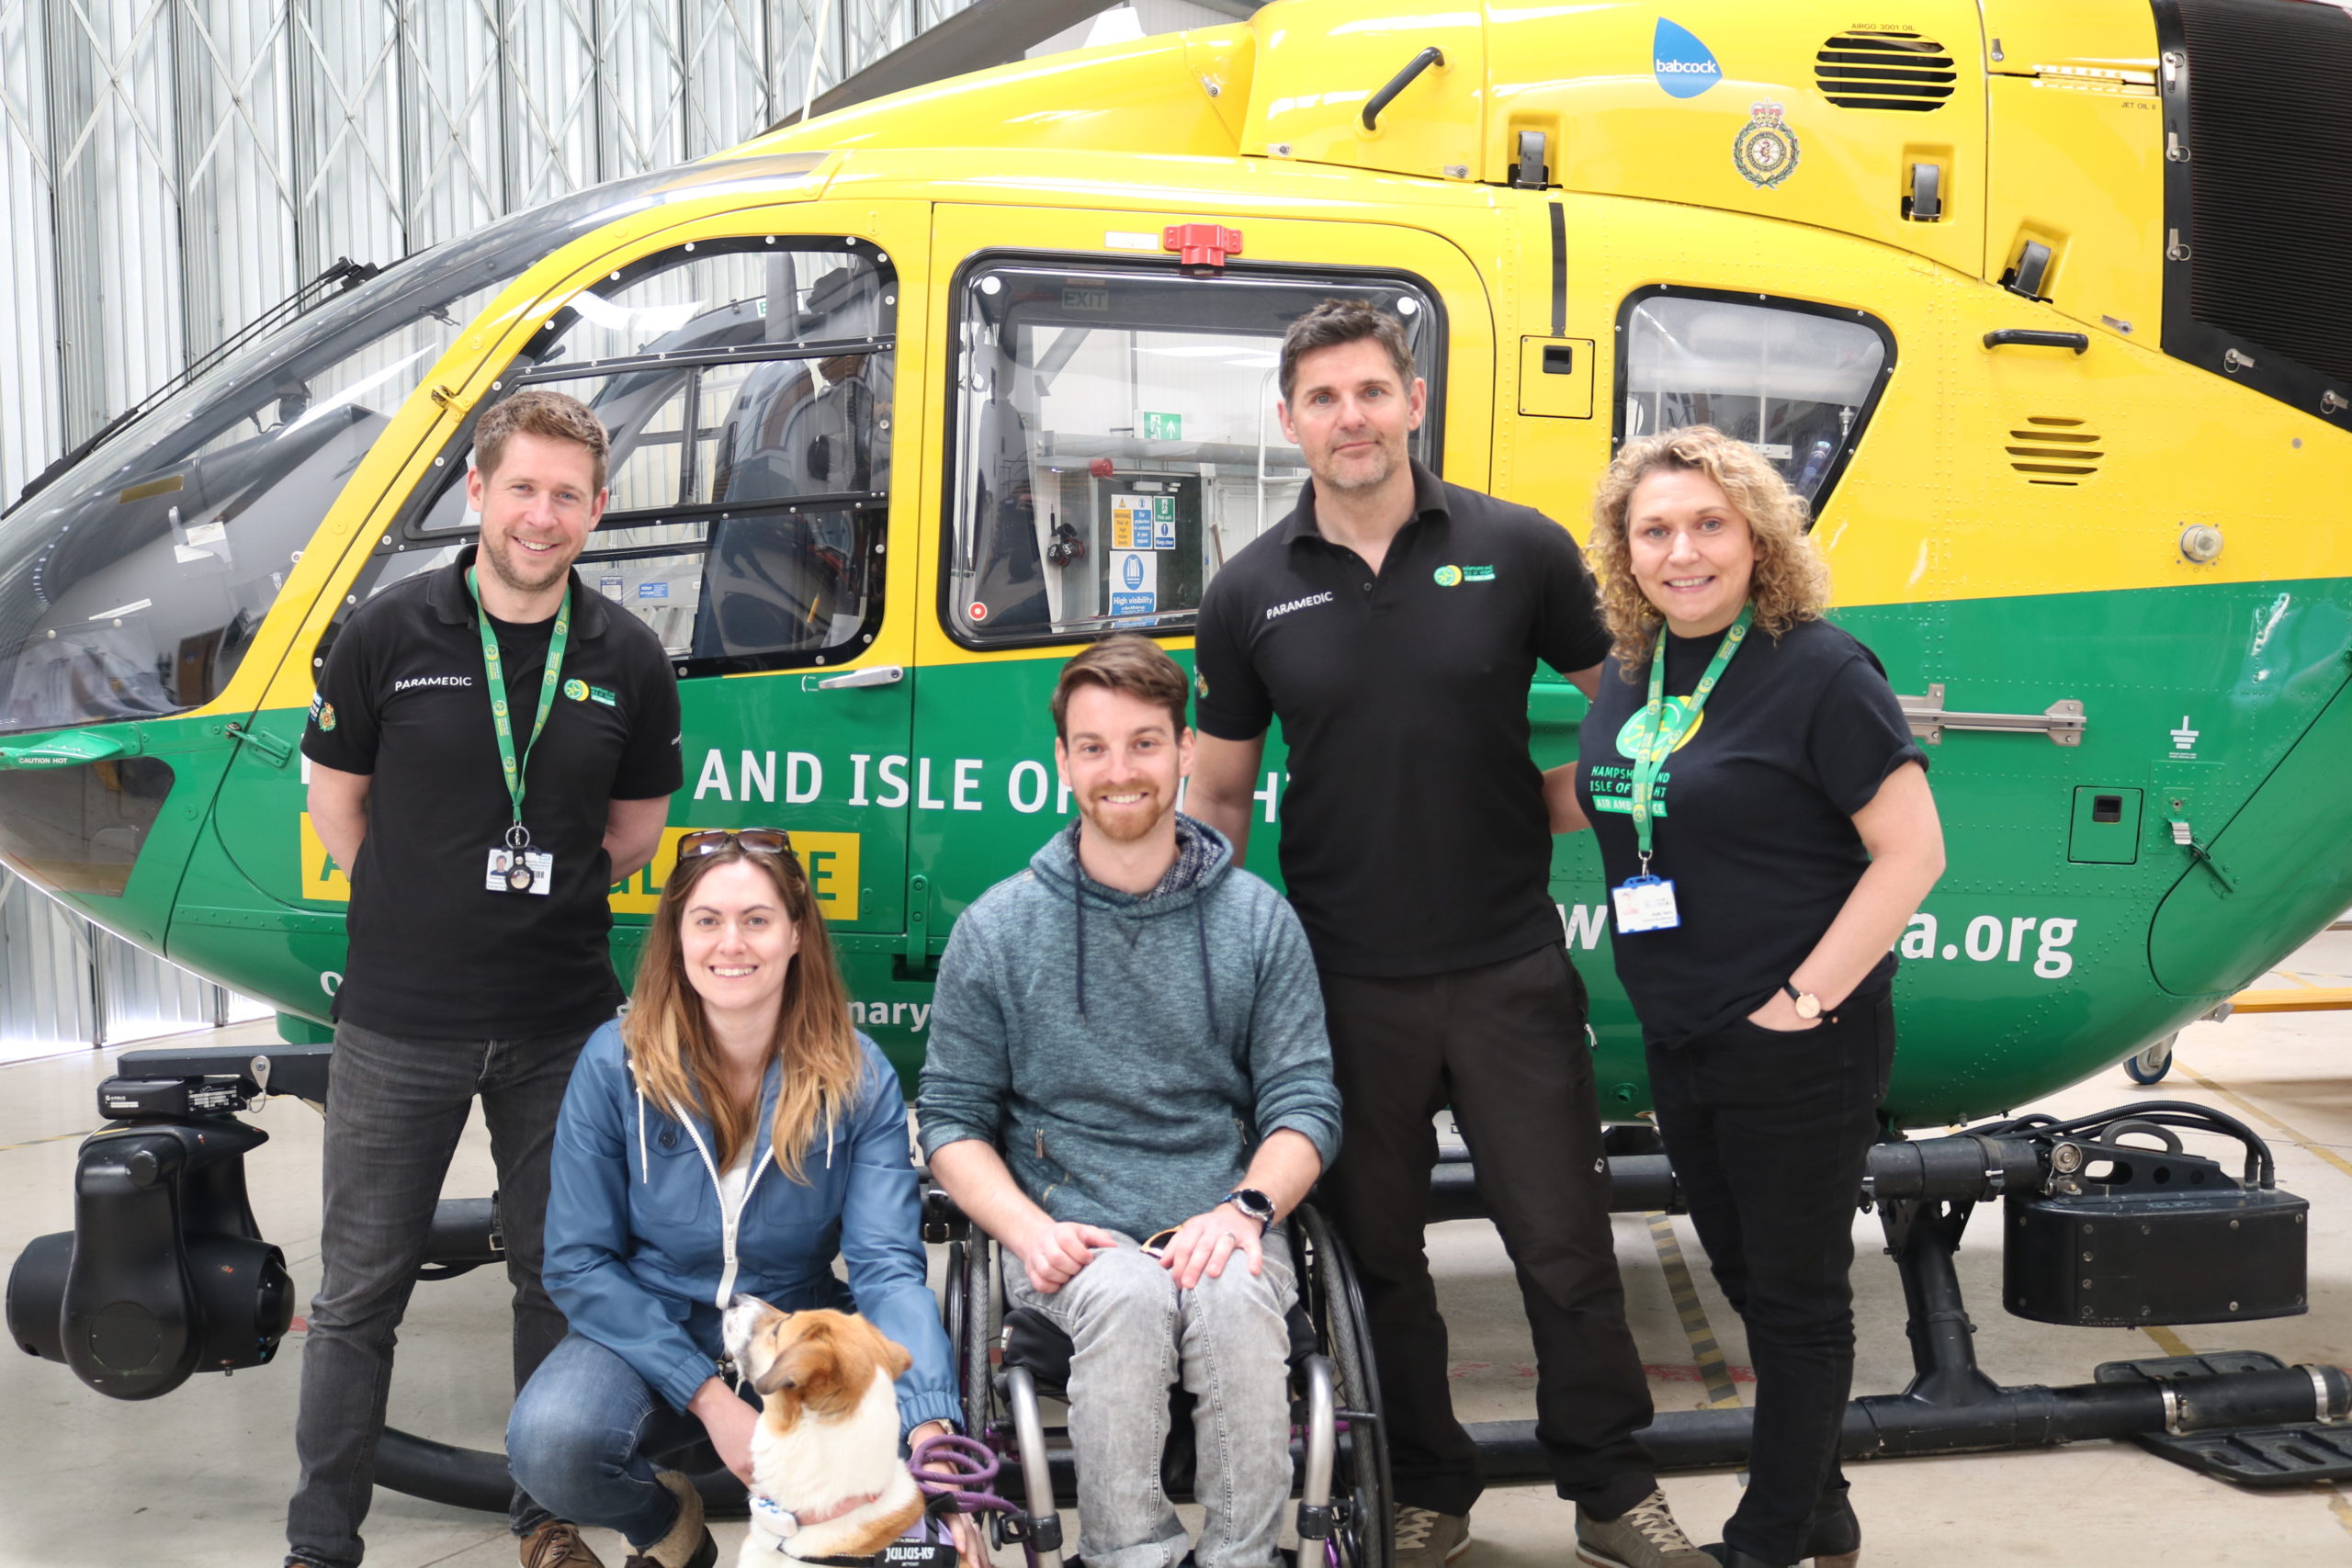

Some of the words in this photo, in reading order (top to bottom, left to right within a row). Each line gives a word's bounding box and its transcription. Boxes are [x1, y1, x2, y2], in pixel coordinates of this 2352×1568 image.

[1656, 59, 1716, 73] babcock
[1064, 290, 1105, 308] EXIT
[1114, 597, 1127, 605] High
[1128, 595, 1153, 604] visibility
[1266, 591, 1333, 620] PARAMEDIC
[395, 676, 472, 692] PARAMEDIC
[693, 748, 823, 804] AND
[848, 753, 984, 811] ISLE
[1589, 780, 1613, 793] ISLE
[1615, 782, 1632, 794] OF
[1596, 797, 1612, 809] AIR
[1891, 912, 2078, 979] a.org
